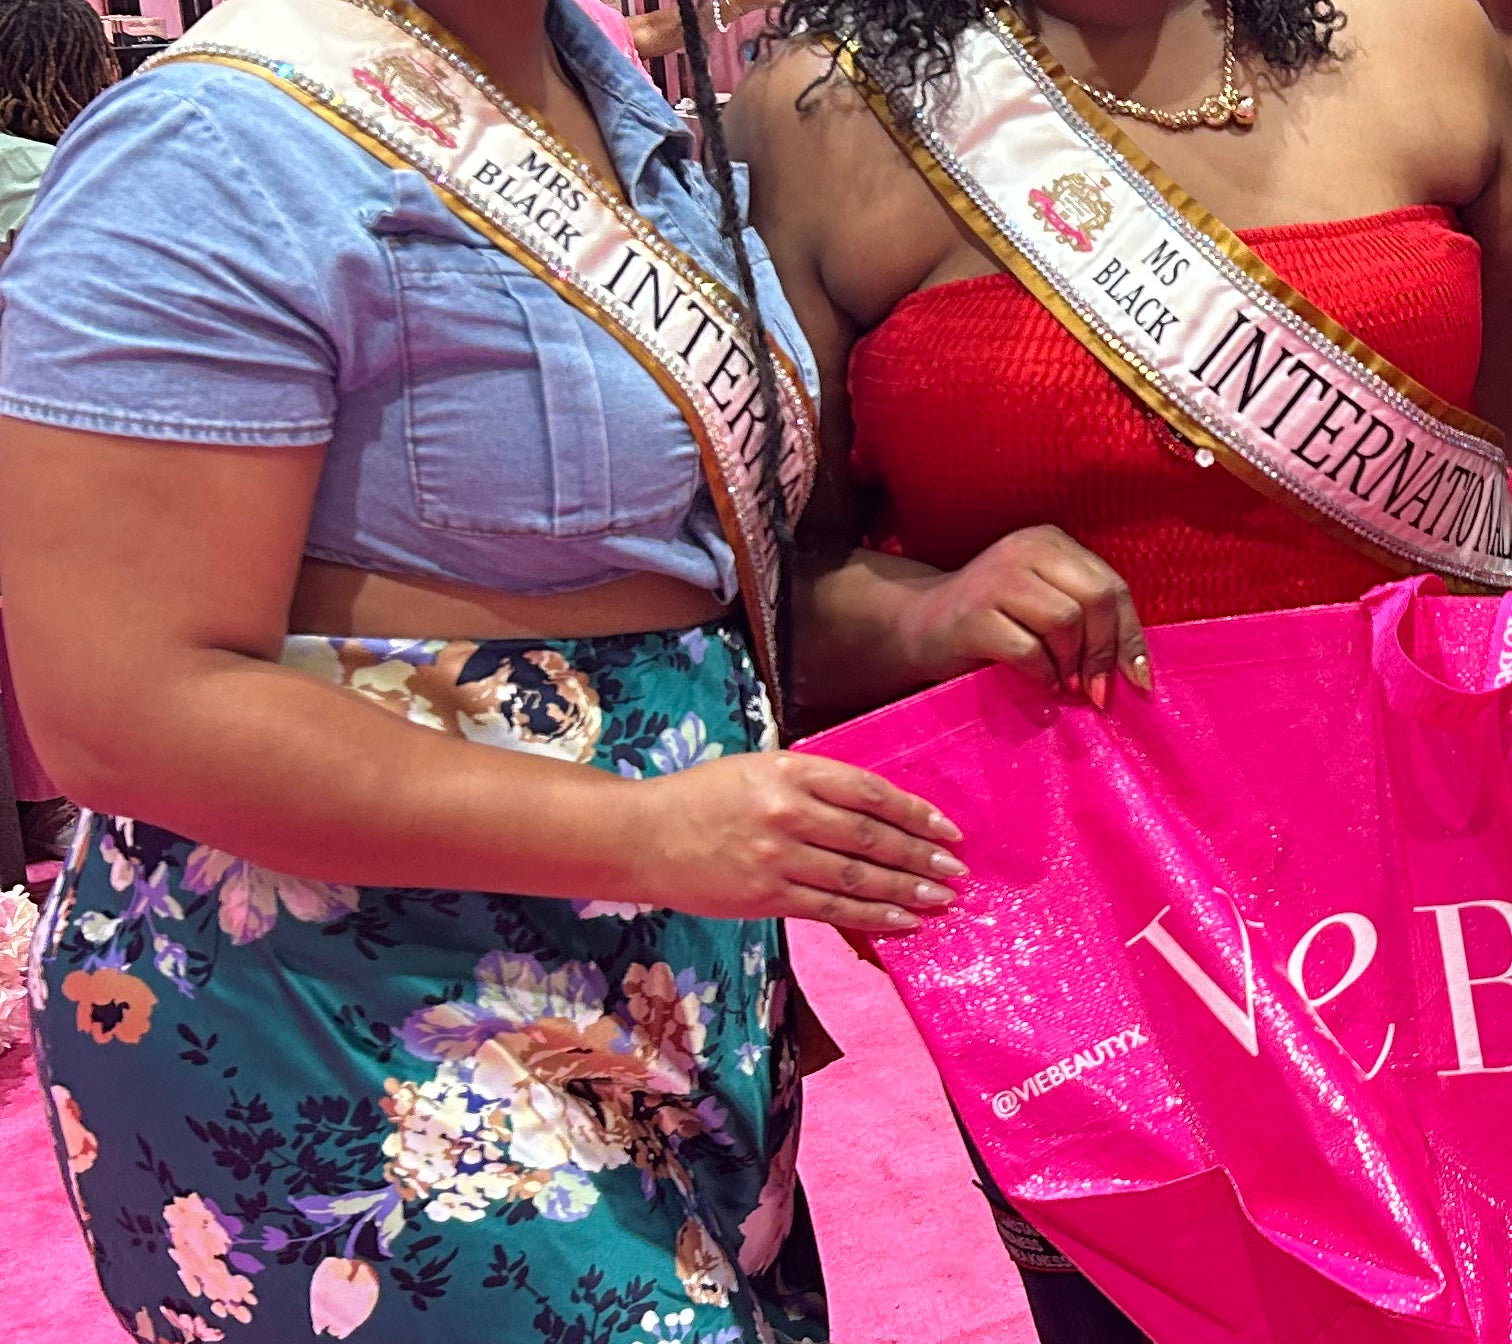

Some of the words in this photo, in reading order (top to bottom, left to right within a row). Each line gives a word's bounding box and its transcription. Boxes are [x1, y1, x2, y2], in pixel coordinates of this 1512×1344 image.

[471, 158, 586, 256] BLACK
[517, 148, 588, 213] MRS
[1091, 256, 1182, 345] BLACK
[1142, 238, 1191, 287] MS
[1189, 309, 1512, 560] INTERNATIONAL
[991, 1023, 1149, 1120] @VIEBEAUTYX
